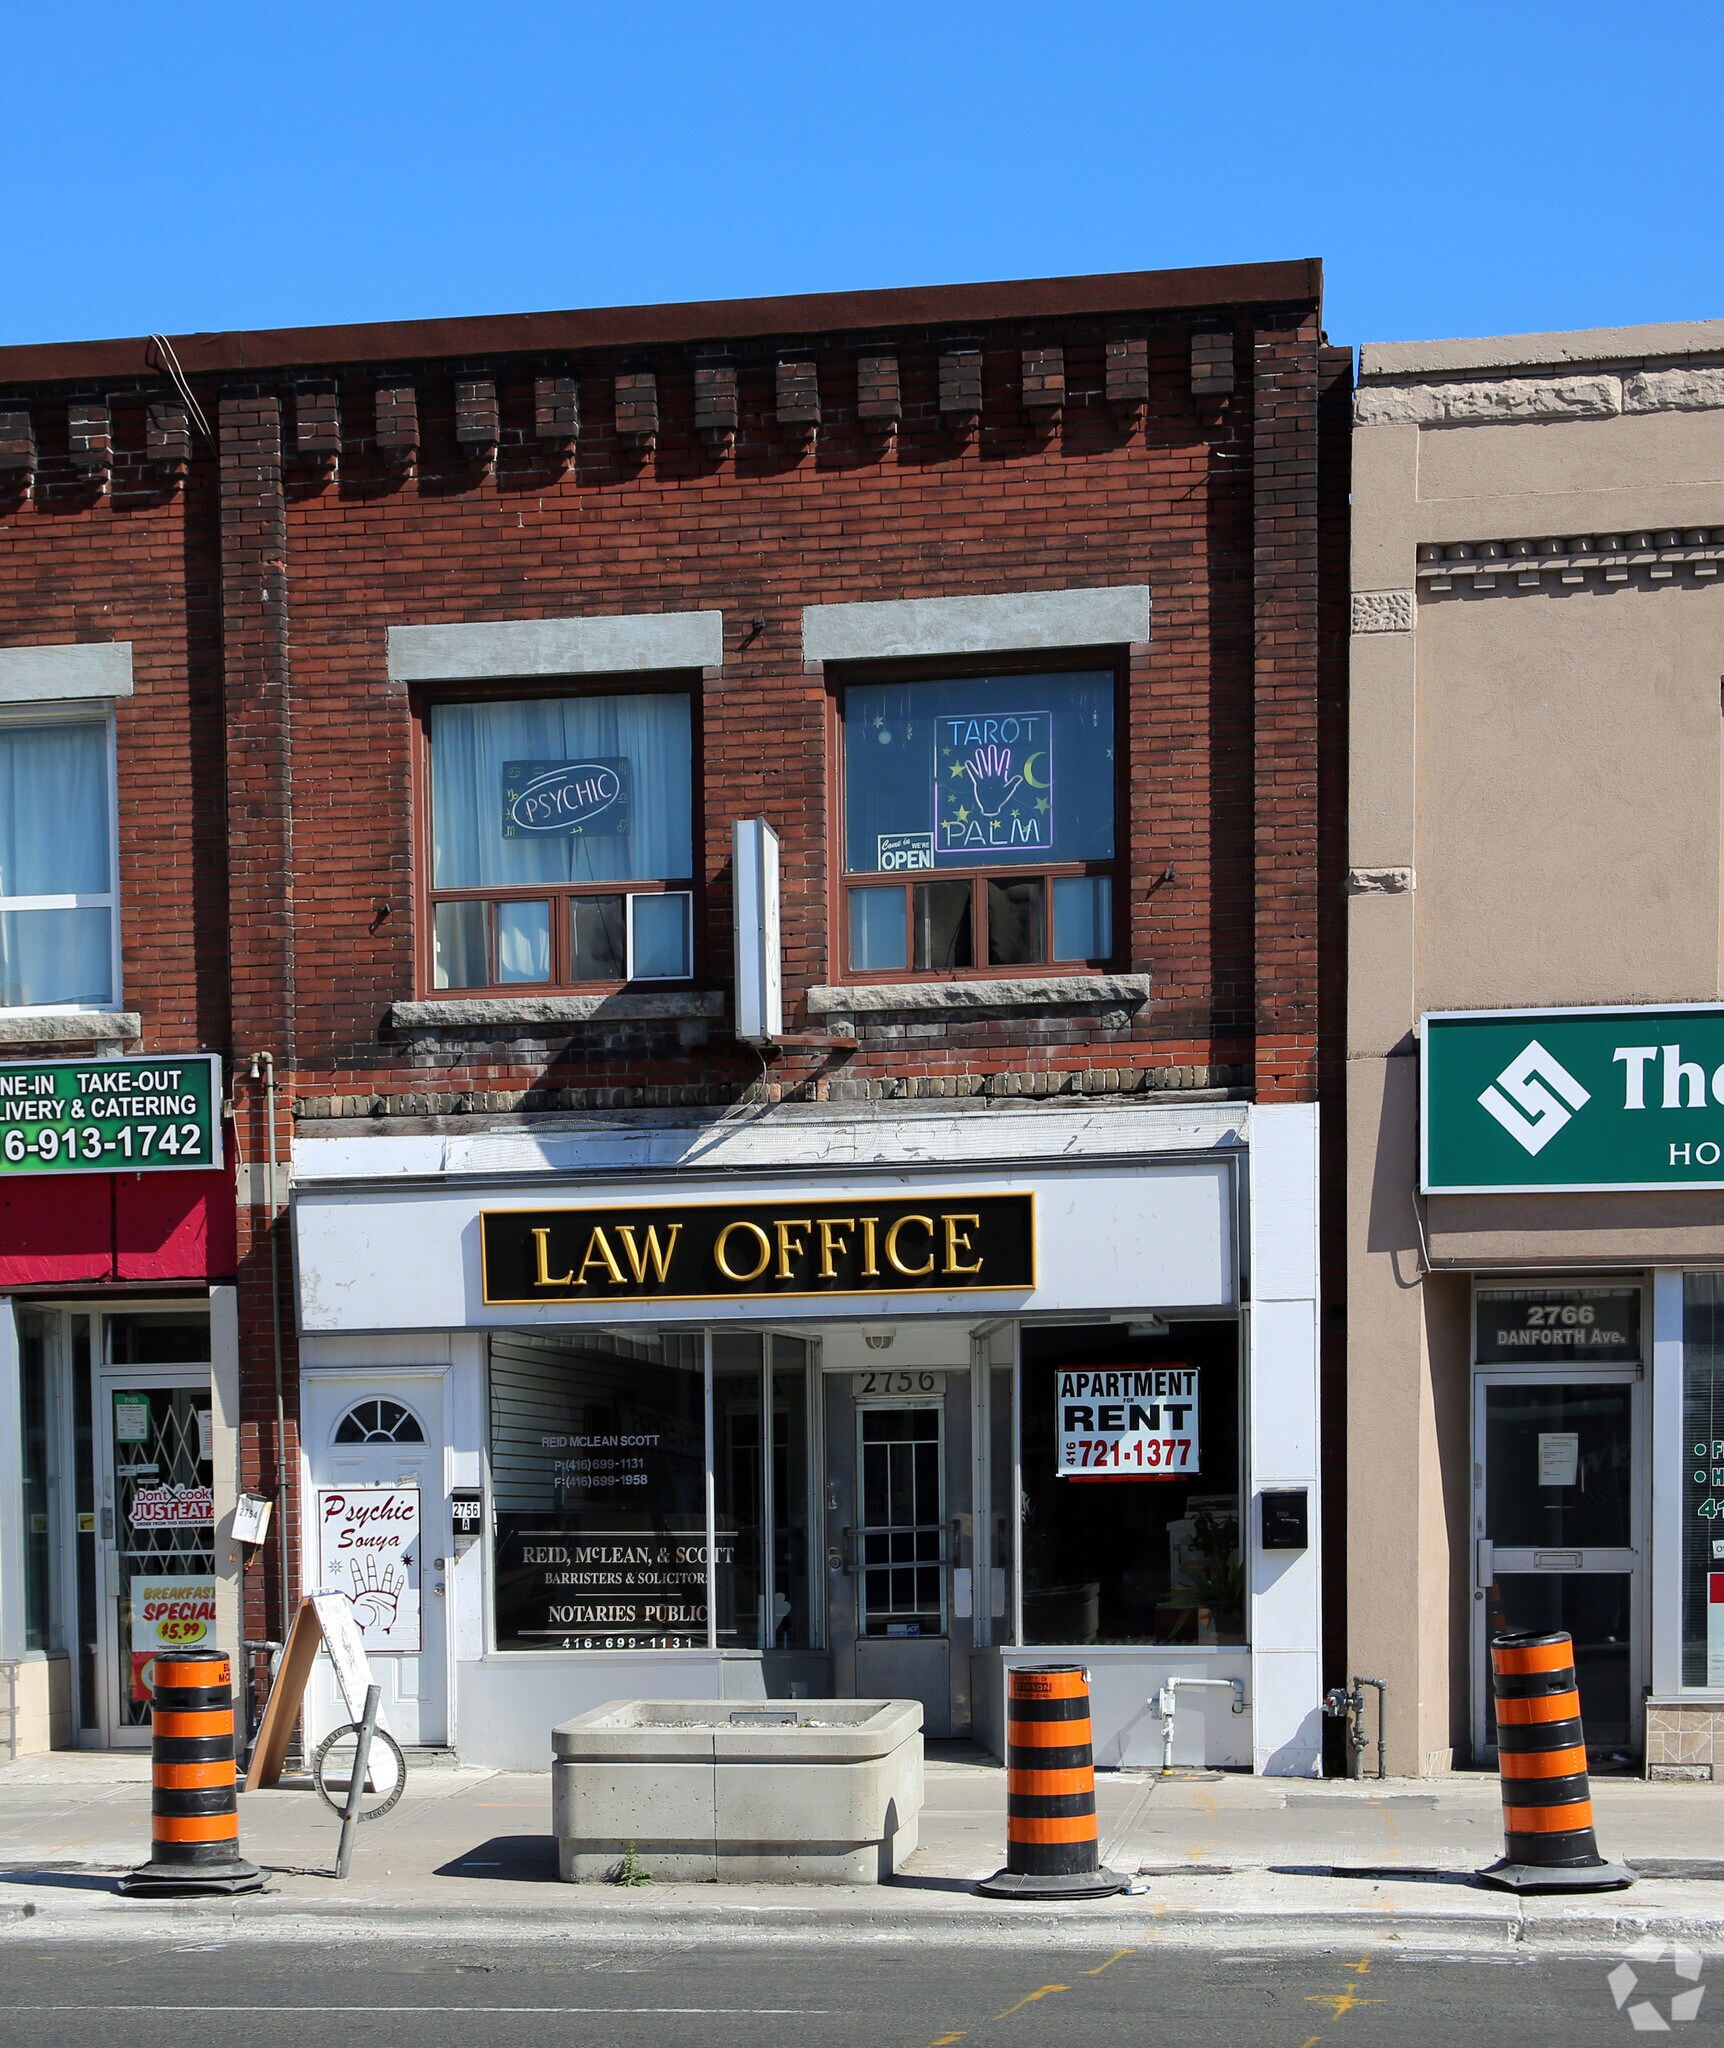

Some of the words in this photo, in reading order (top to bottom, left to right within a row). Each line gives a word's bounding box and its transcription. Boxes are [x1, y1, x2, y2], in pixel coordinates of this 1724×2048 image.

[947, 717, 1040, 746] TAROT
[525, 774, 612, 823] PSYCHIC
[947, 818, 1041, 847] PALM
[882, 839, 902, 851] Come
[911, 841, 930, 849] WE'RE
[881, 850, 931, 870] OPEN
[0, 1075, 55, 1096] NE-IN
[77, 1070, 182, 1094] TAKE-OUT
[70, 1098, 86, 1119] &
[91, 1095, 197, 1118] CATERING
[4, 1124, 201, 1161] 6-913-1742
[1669, 1141, 1721, 1166] HO
[531, 1222, 684, 1288] LAW
[714, 1214, 984, 1282] OFFICE
[1526, 1305, 1596, 1326] 2766
[1497, 1328, 1587, 1346] DANFORTH
[1589, 1328, 1627, 1345] Ave.
[860, 1372, 935, 1393] 2756
[1061, 1371, 1196, 1398] APARTMENT
[1064, 1404, 1193, 1432] RENT
[541, 1436, 567, 1447] REID
[569, 1435, 618, 1447] MCLEAN
[620, 1435, 660, 1446] SCOTT
[1066, 1442, 1076, 1465] 416
[137, 1490, 168, 1501] Don't
[179, 1488, 209, 1500] cook
[133, 1503, 175, 1520] JUST
[239, 1507, 258, 1520] 2754
[324, 1495, 415, 1528] Psychic
[453, 1503, 478, 1517] 2756
[463, 1519, 469, 1529] A
[337, 1528, 401, 1552] Sonya
[522, 1547, 571, 1566] REID,
[657, 1547, 670, 1564] &
[675, 1546, 734, 1564] SCOTT
[544, 1572, 622, 1585] BARRISTERS
[625, 1572, 635, 1585] &
[143, 1586, 216, 1600] BREAKFAST
[143, 1602, 216, 1621] SPECIAL
[548, 1605, 636, 1623] NOTARIES
[644, 1604, 708, 1622] PUBLIC
[161, 1622, 199, 1639] $5.99
[1015, 1683, 1050, 1691] STINSON
